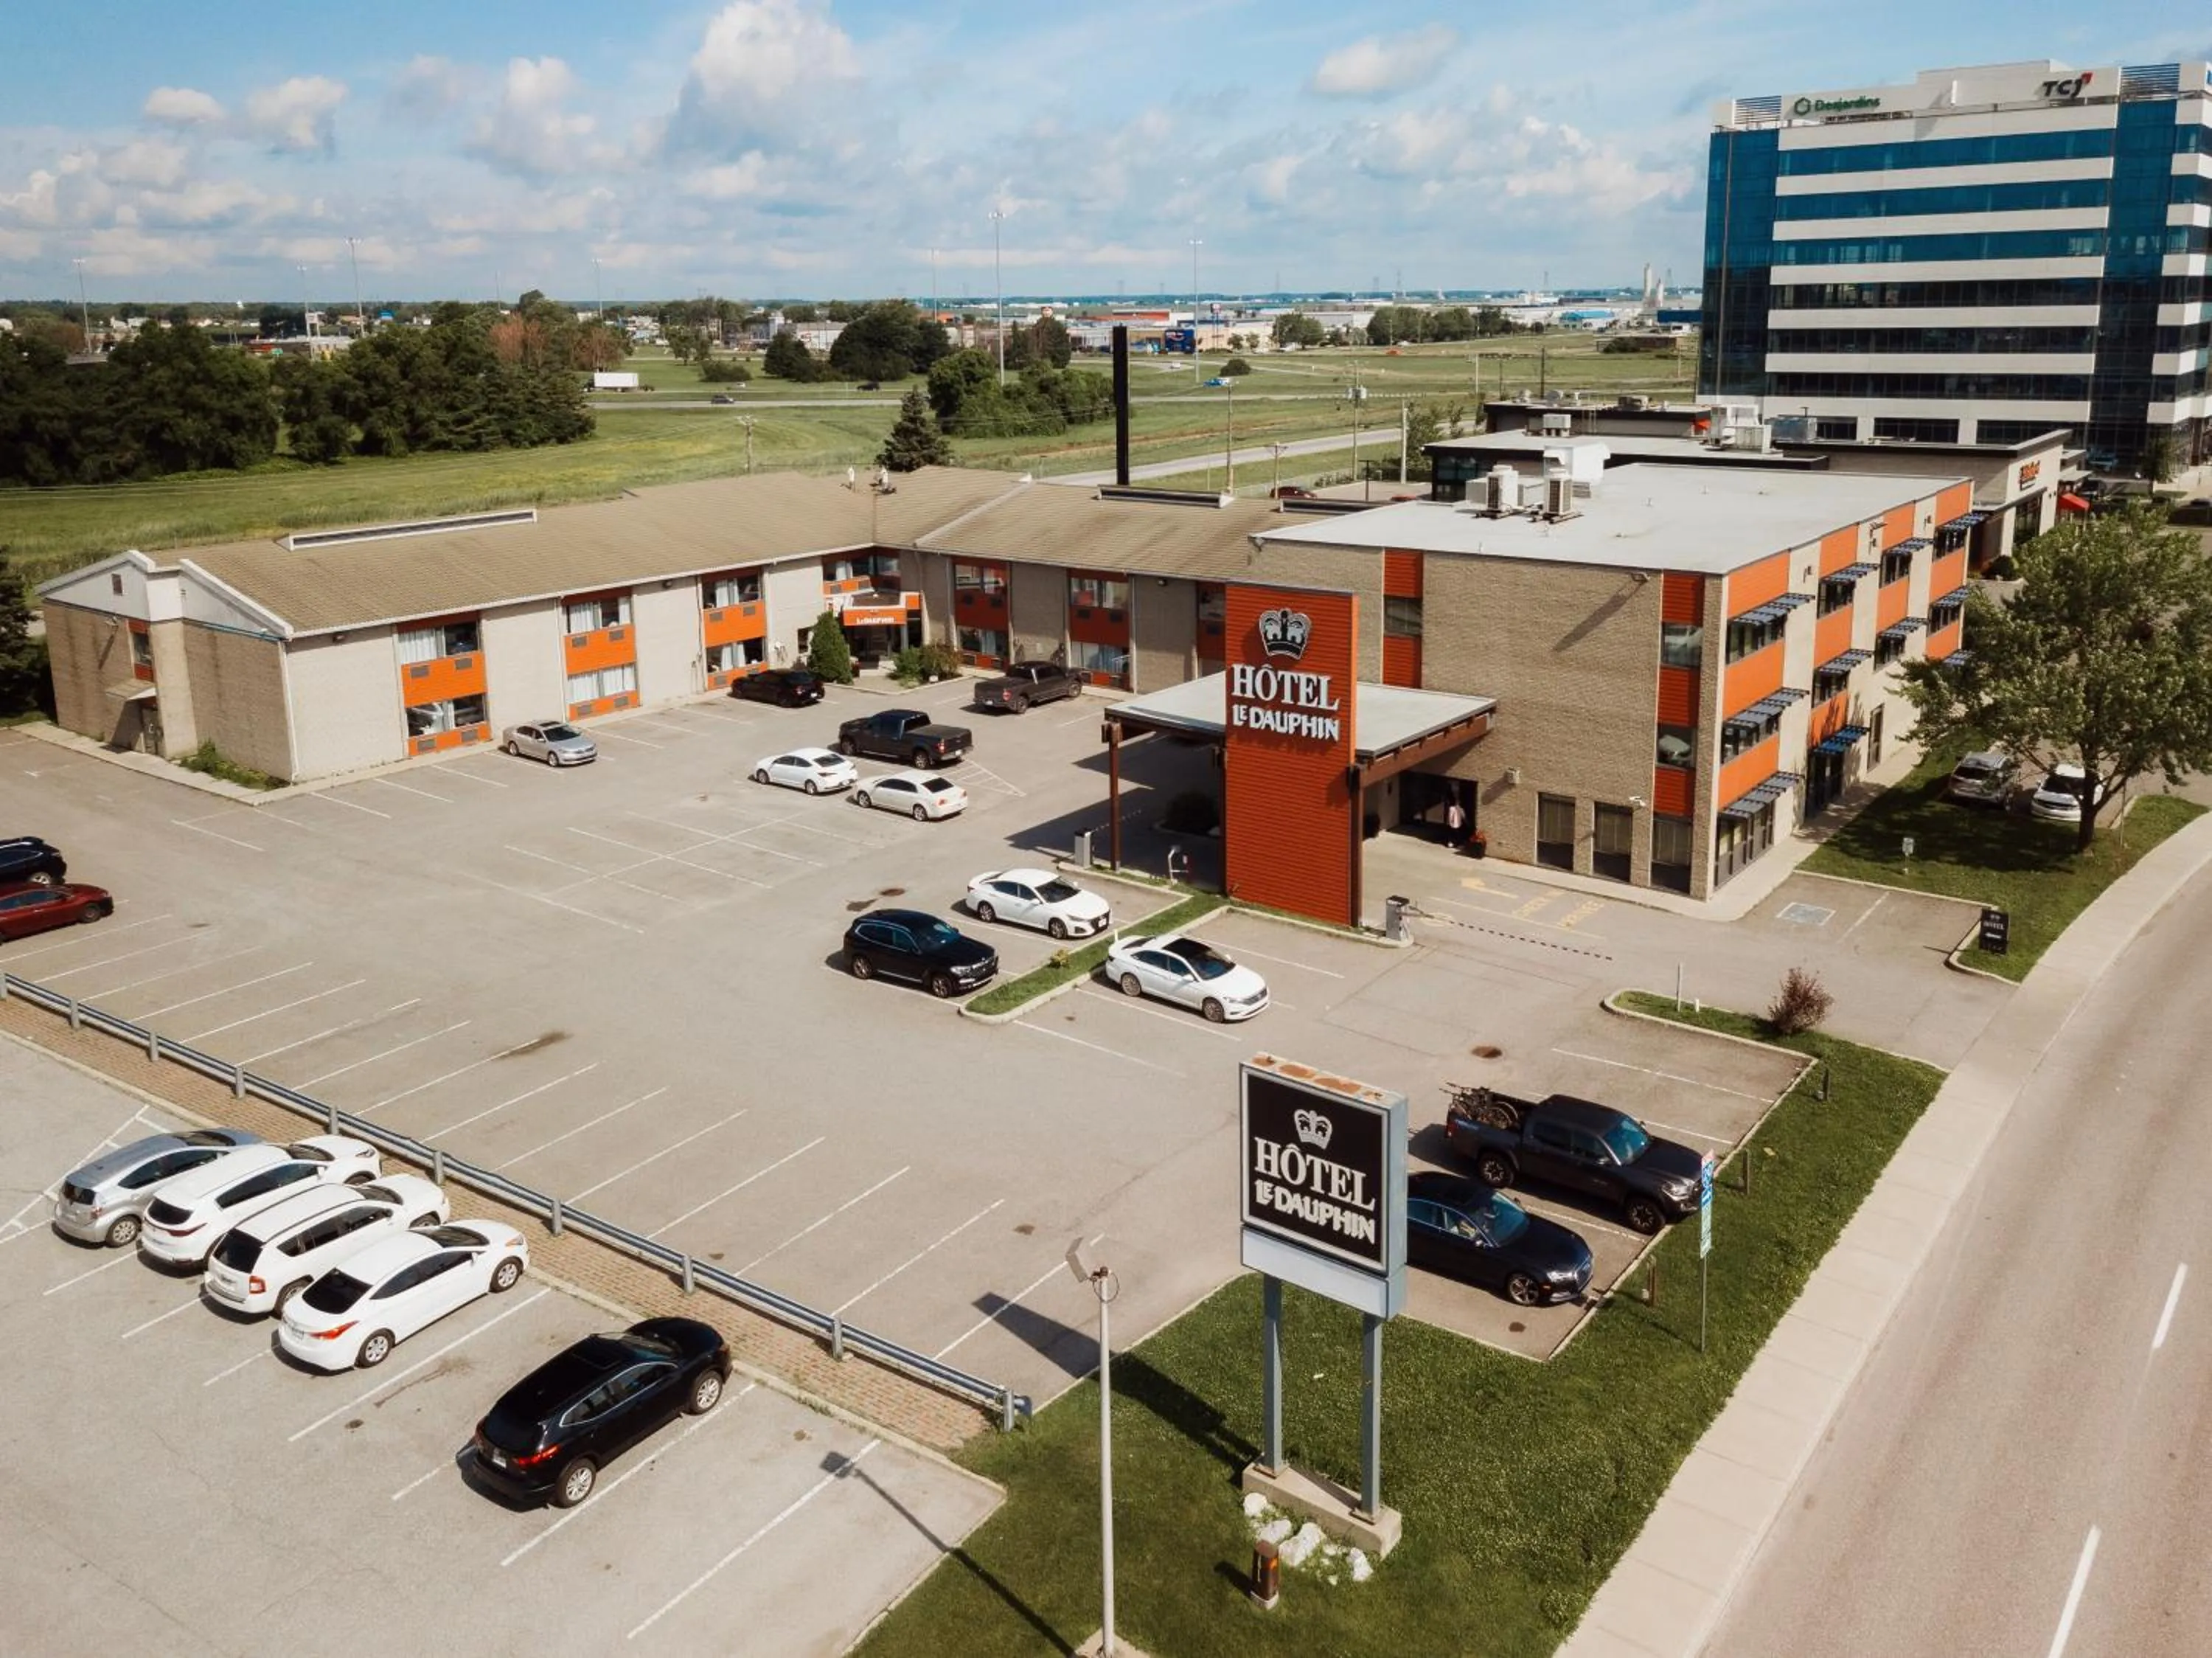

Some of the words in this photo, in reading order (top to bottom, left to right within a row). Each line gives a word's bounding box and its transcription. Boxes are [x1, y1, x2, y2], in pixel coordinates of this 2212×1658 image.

[1815, 95, 1881, 111] Desjardins
[1231, 665, 1340, 710] HÔTEL
[1250, 707, 1339, 740] DAUPHIN
[1254, 1137, 1375, 1211] HÔTEL
[1275, 1185, 1375, 1244] DAUPHIN
